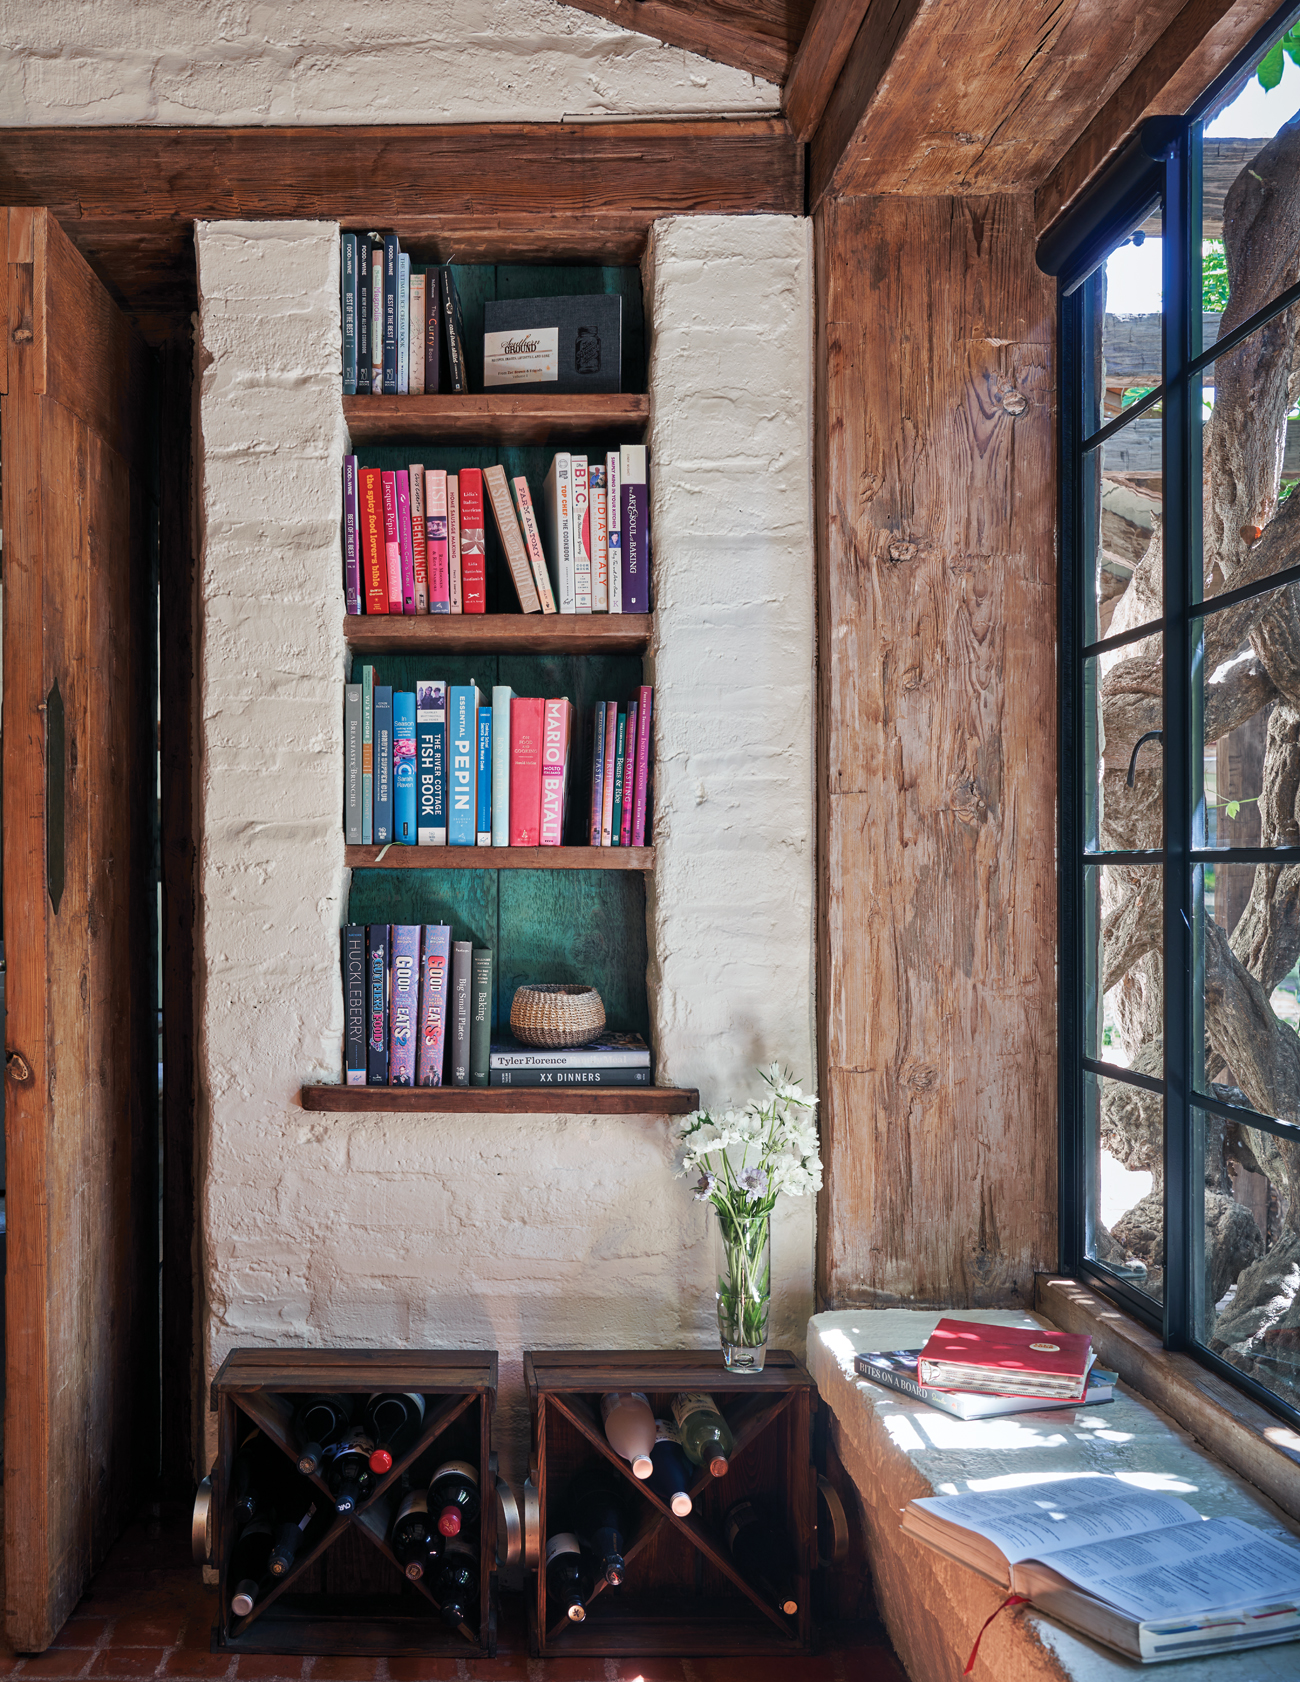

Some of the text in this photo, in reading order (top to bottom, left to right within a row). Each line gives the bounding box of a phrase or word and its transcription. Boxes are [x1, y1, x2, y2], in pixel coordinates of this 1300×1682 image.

[346, 292, 354, 305] BEST
[372, 286, 383, 322] Magnolia
[387, 294, 395, 307] BEST
[346, 313, 354, 322] THE
[346, 323, 354, 337] BEST
[387, 315, 395, 324] THE
[387, 325, 395, 339] BEST
[426, 318, 437, 345] Curry
[504, 344, 537, 354] GROUND
[366, 474, 375, 489] the
[431, 475, 446, 513] FISH
[574, 468, 587, 507] B.T.C.
[366, 490, 376, 514] spicy
[383, 480, 395, 536] Jacques Pépin
[369, 515, 377, 534] food
[488, 473, 534, 586] IT STARTS WITH FRUIT
[518, 487, 541, 558] FARM ANATOMY
[597, 493, 607, 587] LIDIA'S ITALY
[629, 493, 637, 574] ART SOUL BAKING
[371, 535, 379, 564] lover's
[411, 515, 427, 584] BEGINNINGS
[562, 530, 570, 562] COOKBOOK
[372, 565, 381, 587] bible
[388, 543, 400, 602] Fast Food My Way
[545, 703, 562, 762] MARIO
[350, 720, 358, 808] BREAKFASTS BRUNCHES
[421, 735, 434, 768] FISH
[434, 734, 442, 816] THE RIVER COTTAGE
[454, 740, 470, 810] PEPIN
[615, 757, 624, 804] Beans & Rice
[625, 758, 633, 803] ROASTING
[638, 761, 646, 790] NATIONS
[421, 774, 434, 816] BOOK
[542, 778, 560, 837] BATALI
[396, 955, 414, 992] GOOD
[428, 955, 447, 992] GOOD
[348, 940, 363, 1044] HUCKLEBERRY
[372, 958, 384, 1043] GUY FIERI FOOD
[457, 978, 467, 1041] Big Small Plates
[475, 992, 487, 1021] Baking
[394, 1007, 411, 1039] EATS
[425, 1006, 443, 1038] EATS
[497, 1056, 567, 1067] Tyler Florence
[539, 1073, 601, 1082] XX DINNERS
[569, 1055, 628, 1065] Family Meal
[858, 1361, 882, 1379] BITES
[882, 1371, 894, 1384] ON
[894, 1376, 901, 1387] A
[901, 1379, 929, 1399] BOARD
